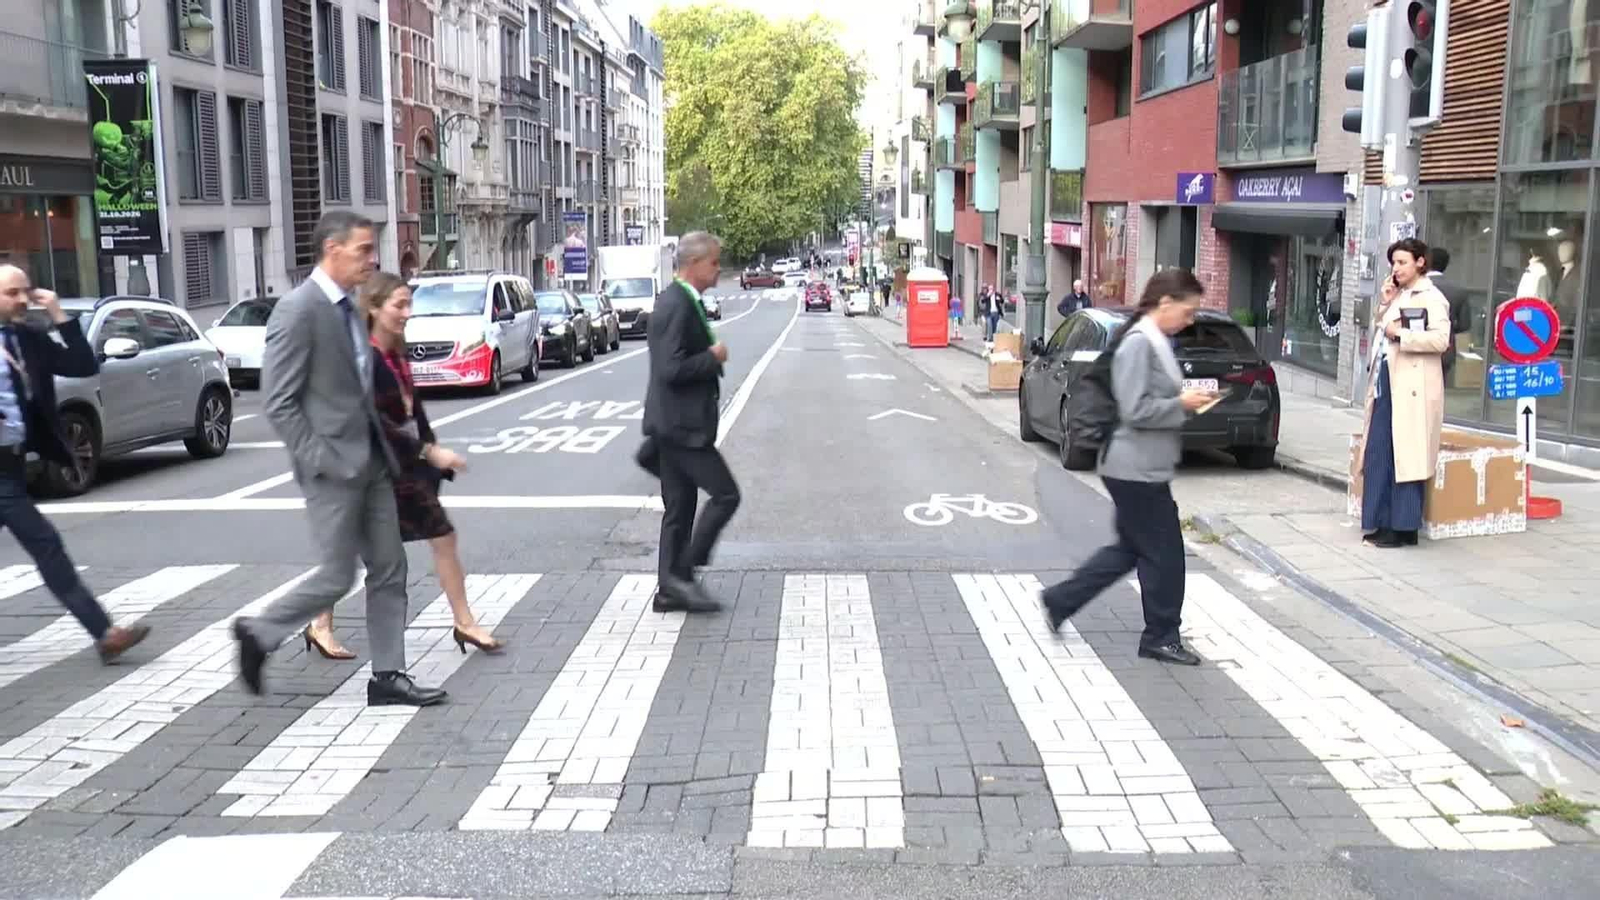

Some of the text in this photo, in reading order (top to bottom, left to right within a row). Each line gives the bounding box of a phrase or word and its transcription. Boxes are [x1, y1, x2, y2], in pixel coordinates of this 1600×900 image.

[86, 72, 134, 85] Terminal
[1, 166, 34, 186] AUL
[1238, 177, 1281, 197] OAKBERRY
[98, 203, 157, 211] HALLOWEEN
[467, 426, 627, 453] BUS
